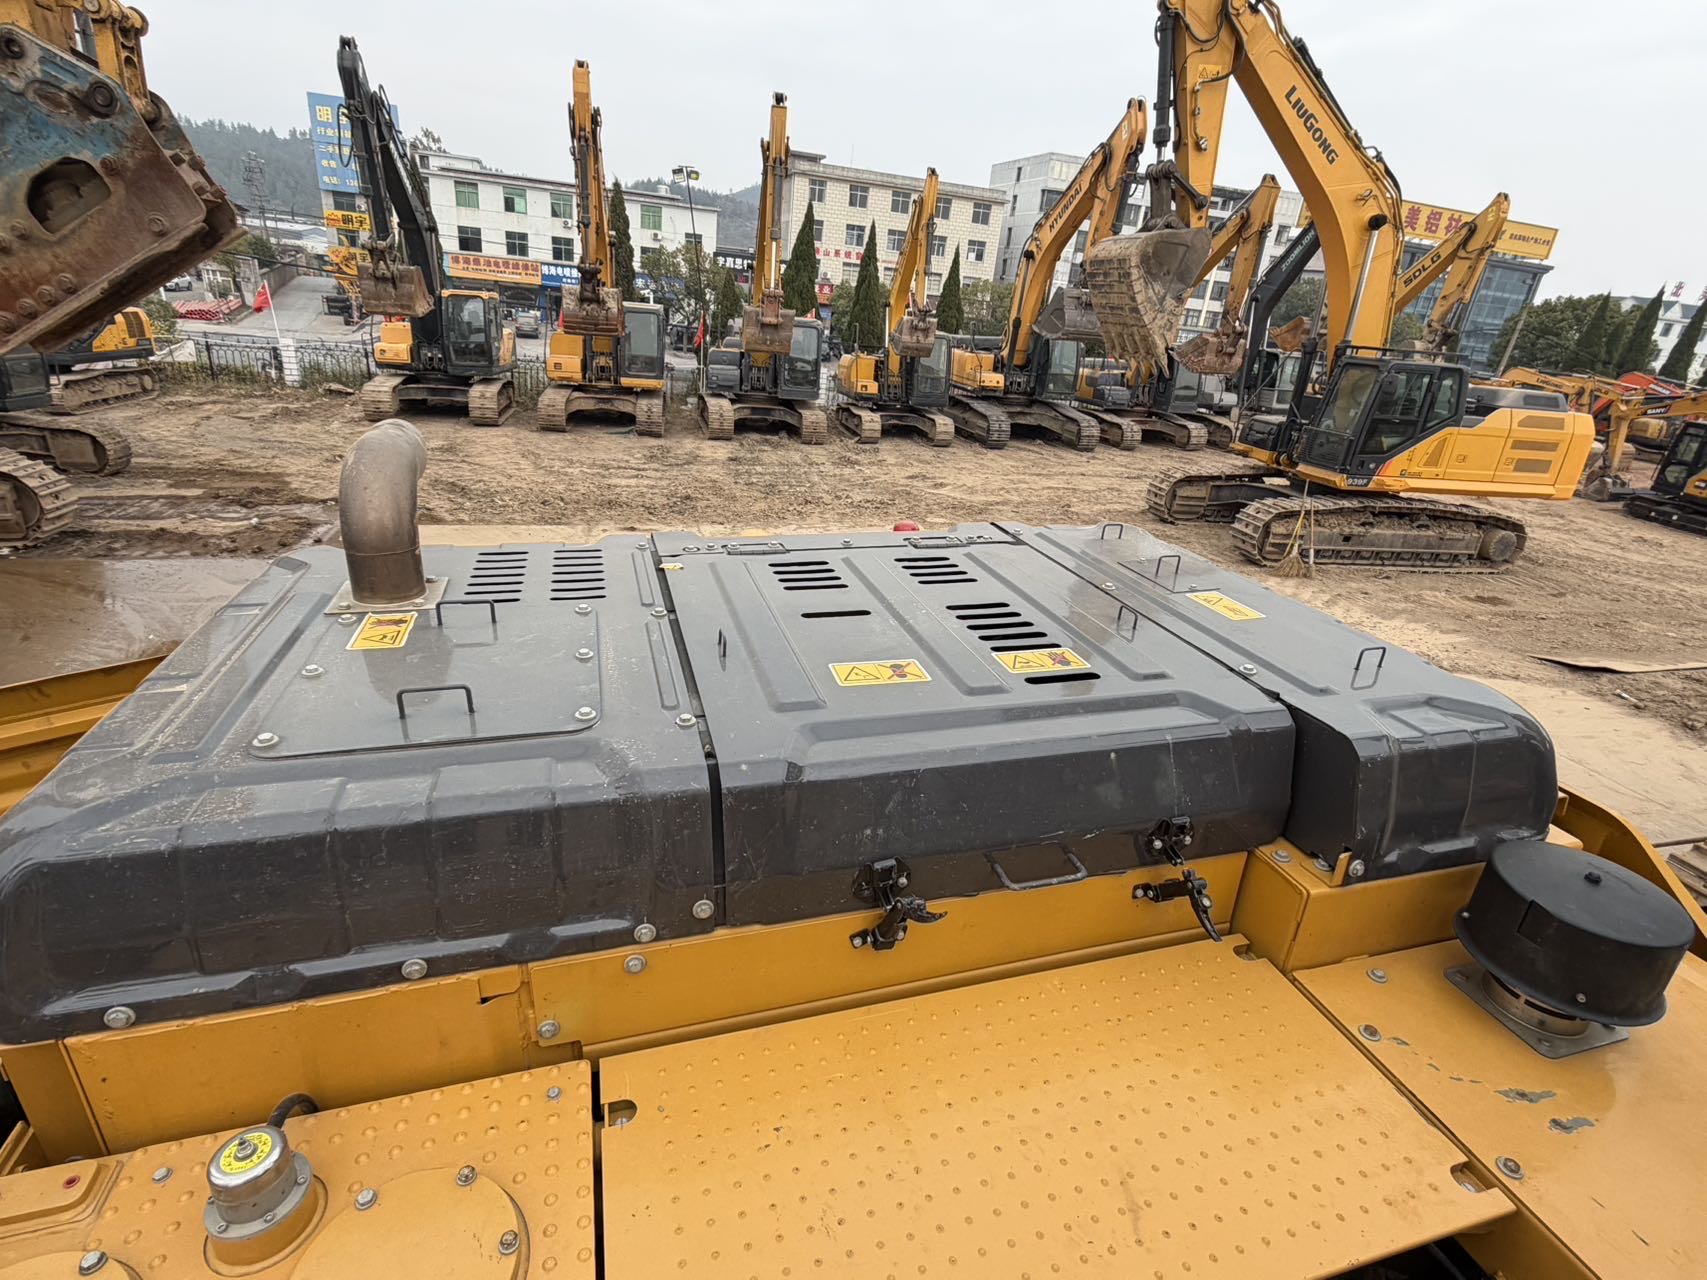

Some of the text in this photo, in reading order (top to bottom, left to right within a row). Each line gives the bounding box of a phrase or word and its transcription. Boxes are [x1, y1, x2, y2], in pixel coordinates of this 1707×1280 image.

[1284, 84, 1340, 166] LIUGONG
[1048, 182, 1083, 233] HYUNDAI
[1402, 250, 1442, 289] SDLG
[1347, 478, 1369, 487] 939F
